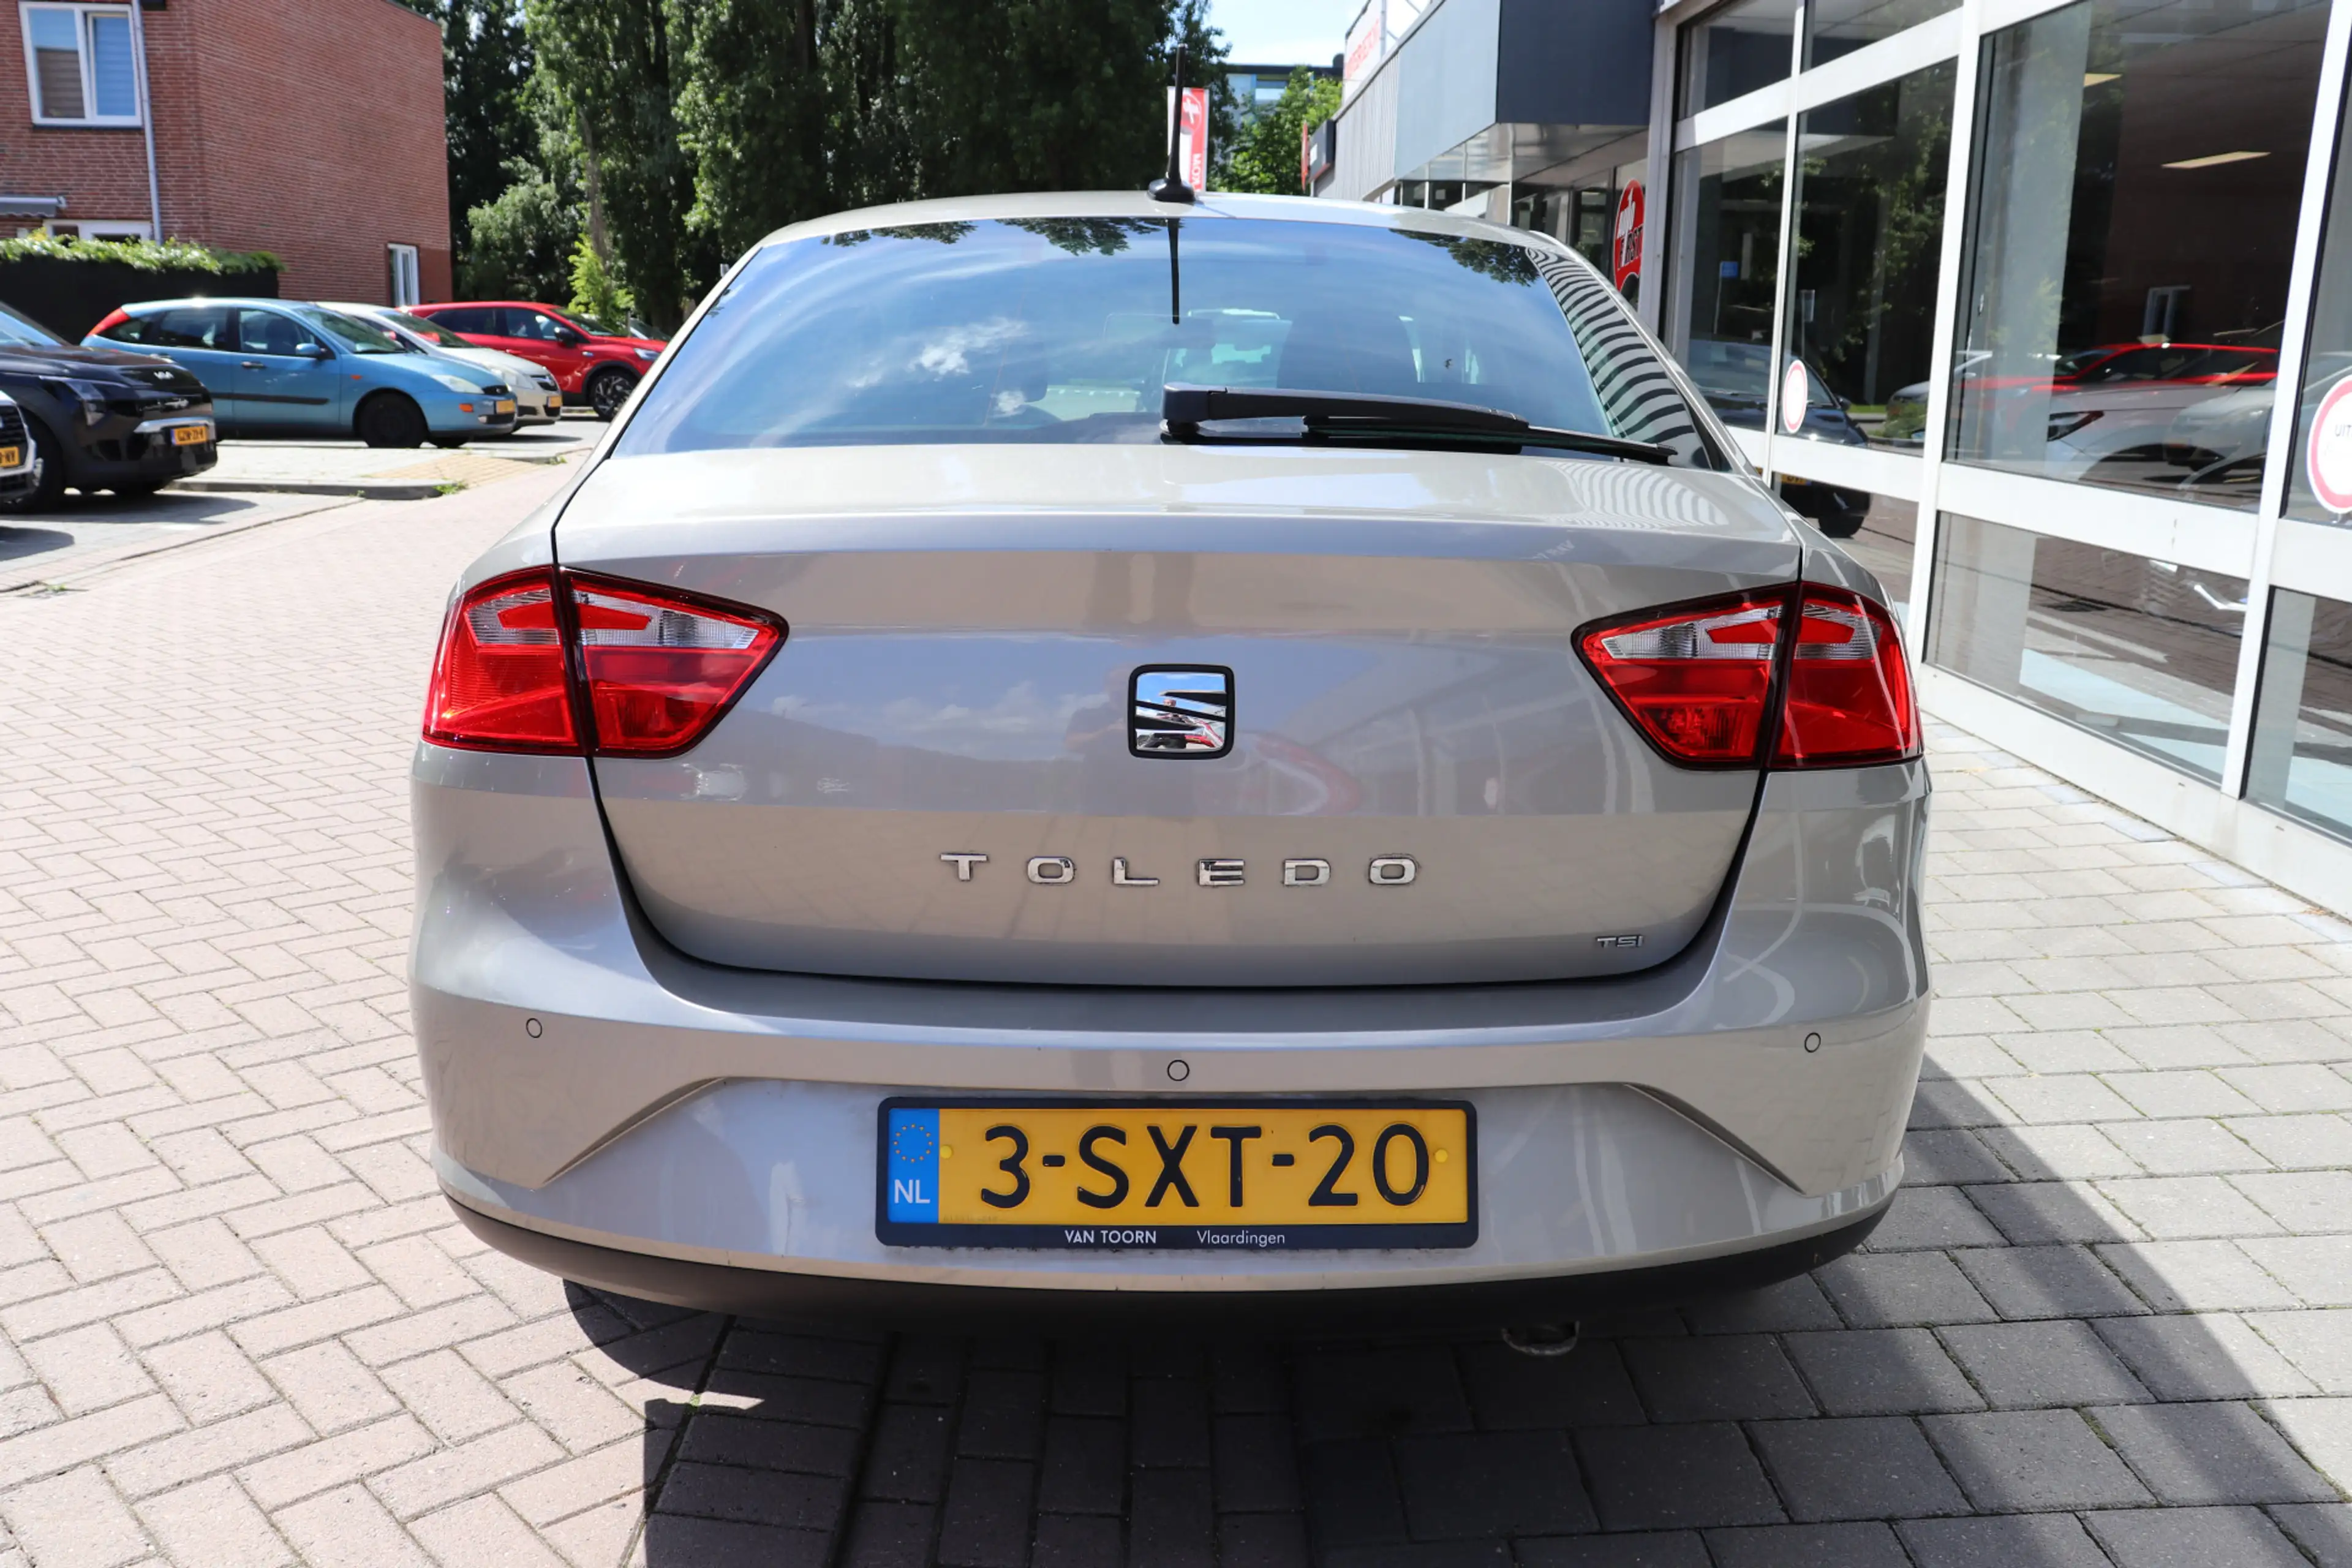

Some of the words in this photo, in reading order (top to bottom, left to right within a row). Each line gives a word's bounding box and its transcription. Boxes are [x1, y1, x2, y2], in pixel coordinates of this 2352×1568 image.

[2334, 423, 2352, 438] UIT
[940, 853, 1417, 886] TOLEDO
[1596, 935, 1643, 948] TSI
[981, 1123, 1430, 1209] 3-SXT-20
[894, 1178, 931, 1204] NL
[1065, 1230, 1095, 1244] VAN
[1101, 1230, 1157, 1244] TOORN
[1197, 1230, 1286, 1248] Vlaardingen
